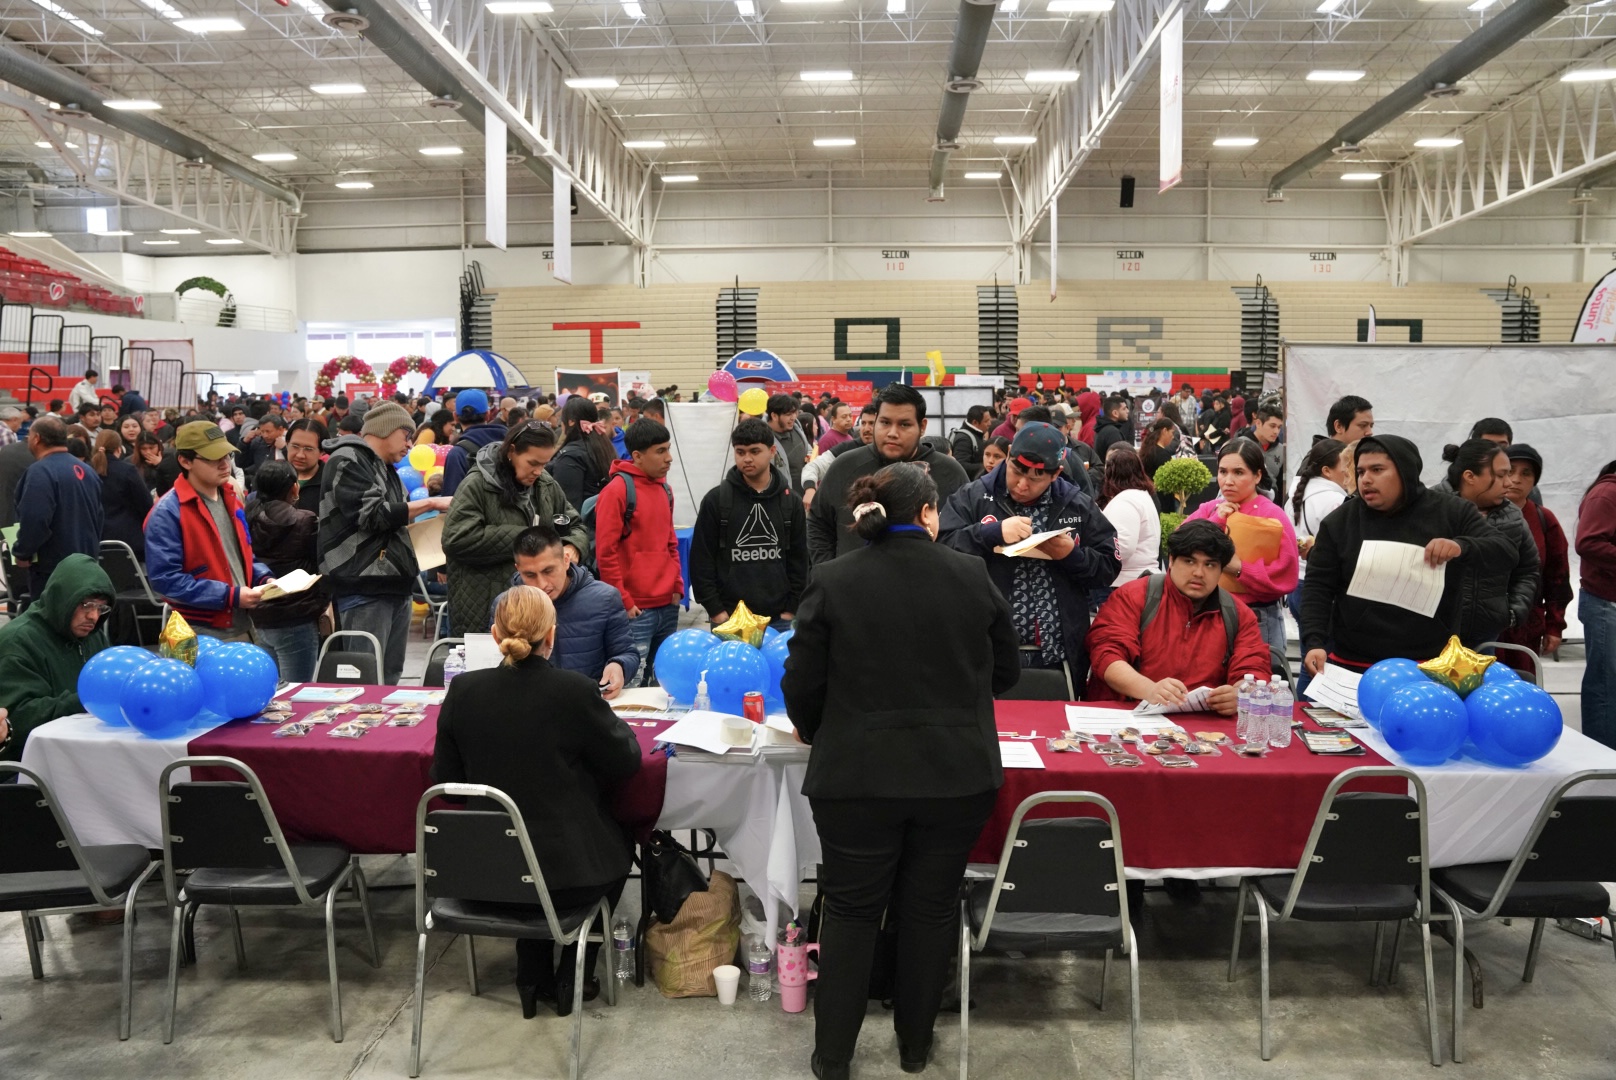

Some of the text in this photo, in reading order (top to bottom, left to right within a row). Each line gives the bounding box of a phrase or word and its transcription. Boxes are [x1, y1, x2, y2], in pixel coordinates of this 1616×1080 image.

[1122, 262, 1141, 271] 120
[1583, 287, 1608, 330] Juntos
[731, 546, 782, 561] Reebok
